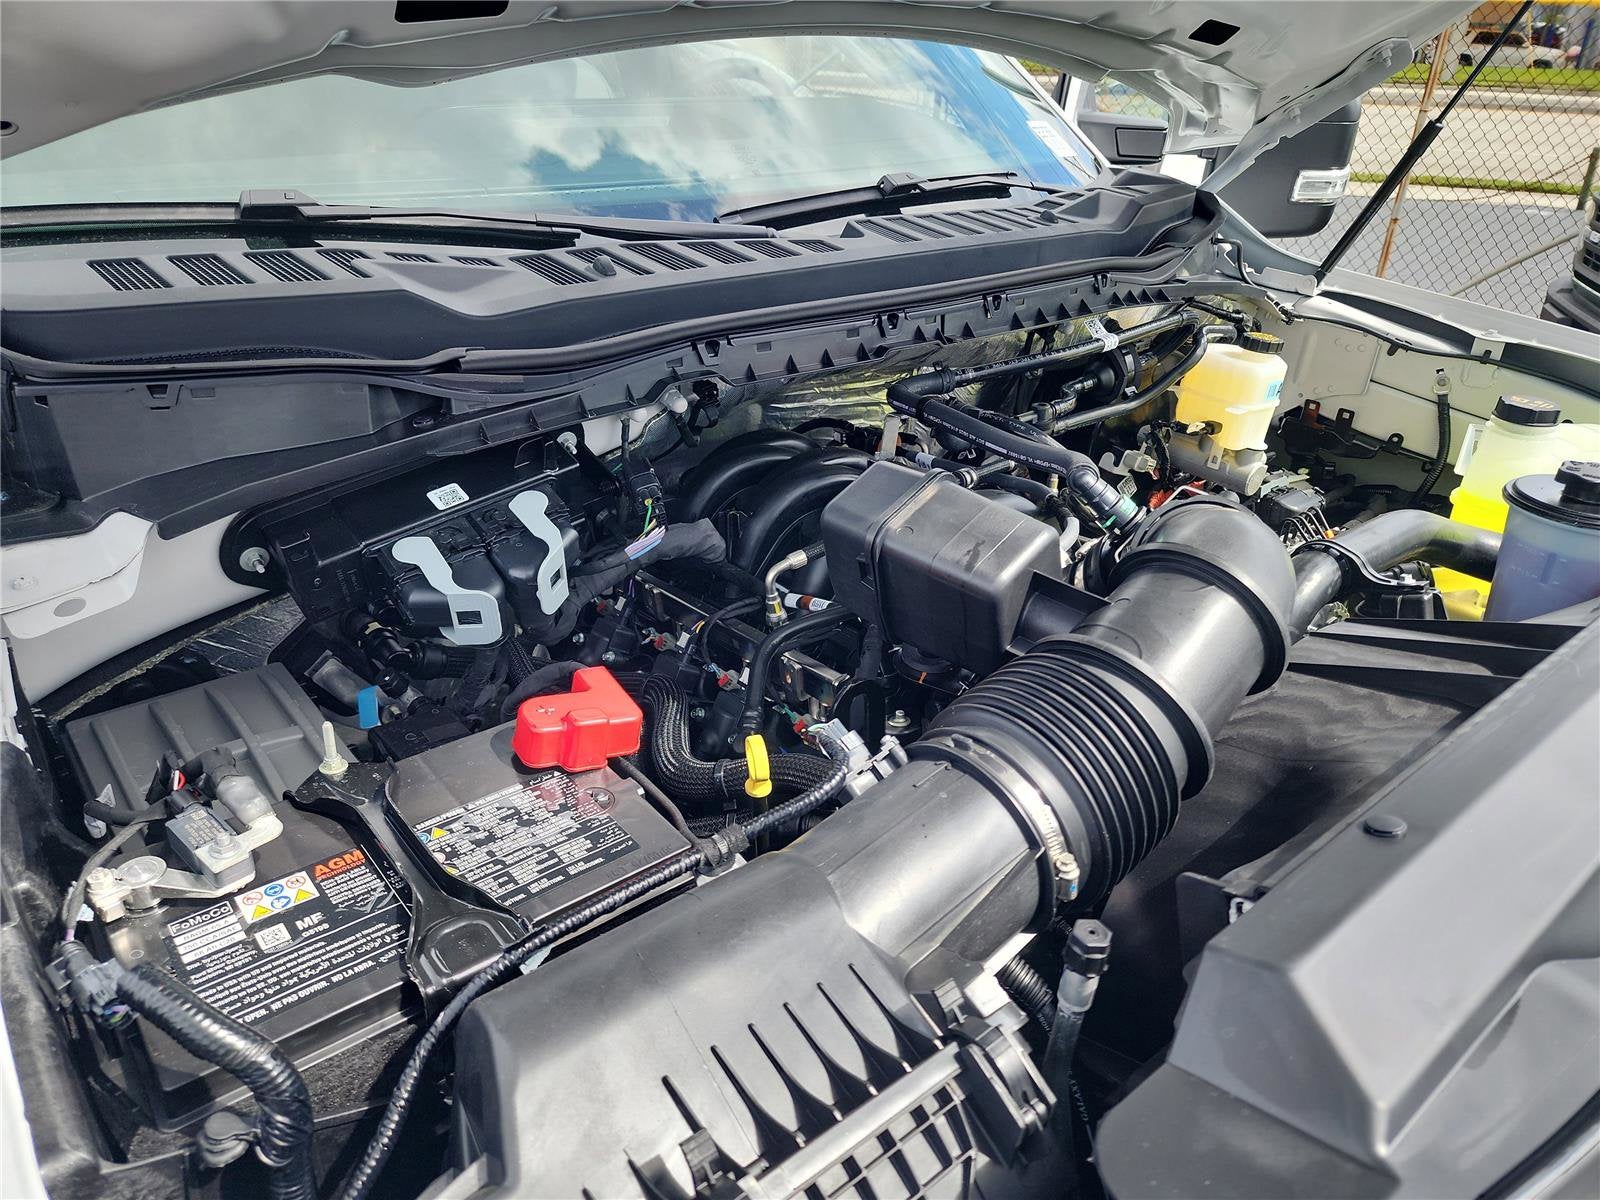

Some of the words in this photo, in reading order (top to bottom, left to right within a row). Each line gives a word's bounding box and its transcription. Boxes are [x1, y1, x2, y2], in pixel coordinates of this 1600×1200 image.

[314, 849, 365, 876] AGM
[171, 905, 231, 933] FoMoCo
[295, 912, 324, 930] MF
[244, 1008, 269, 1022] OPEN.
